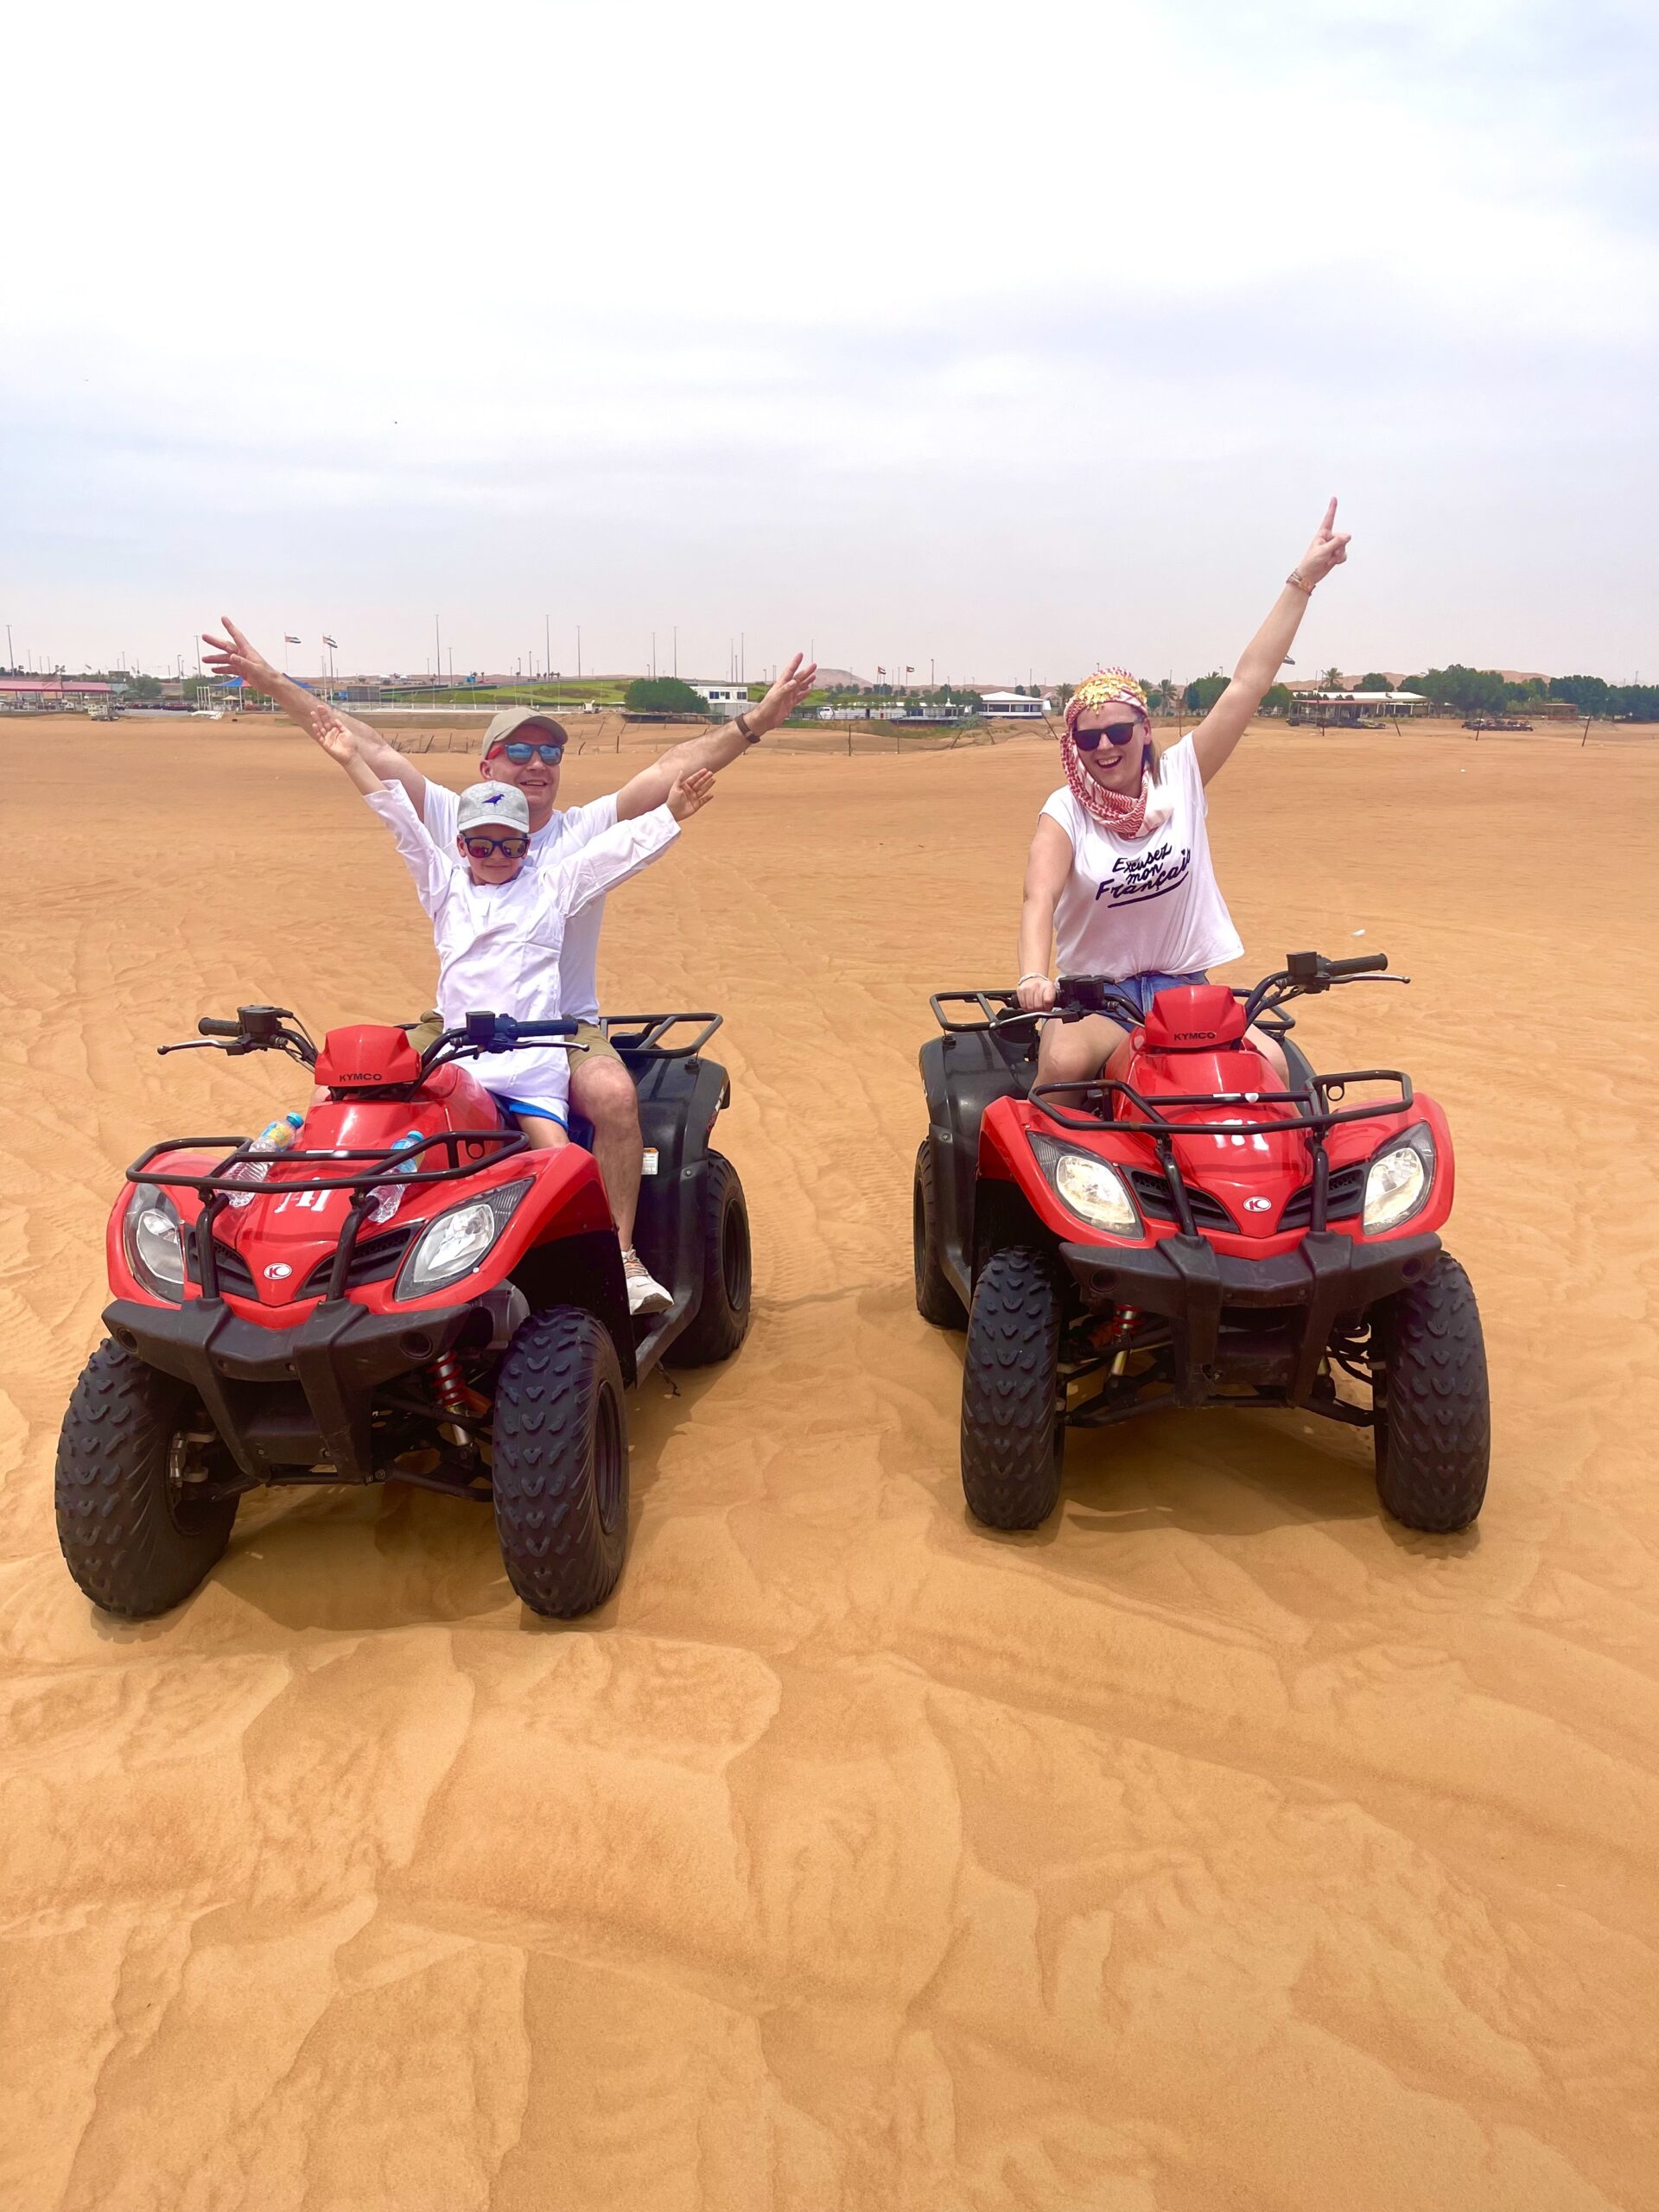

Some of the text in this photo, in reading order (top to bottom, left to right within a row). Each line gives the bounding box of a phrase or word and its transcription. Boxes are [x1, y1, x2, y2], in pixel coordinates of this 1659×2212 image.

[1126, 862, 1164, 885] mon
[1174, 1032, 1216, 1041] KYMCO
[340, 1073, 382, 1082] KYMCO
